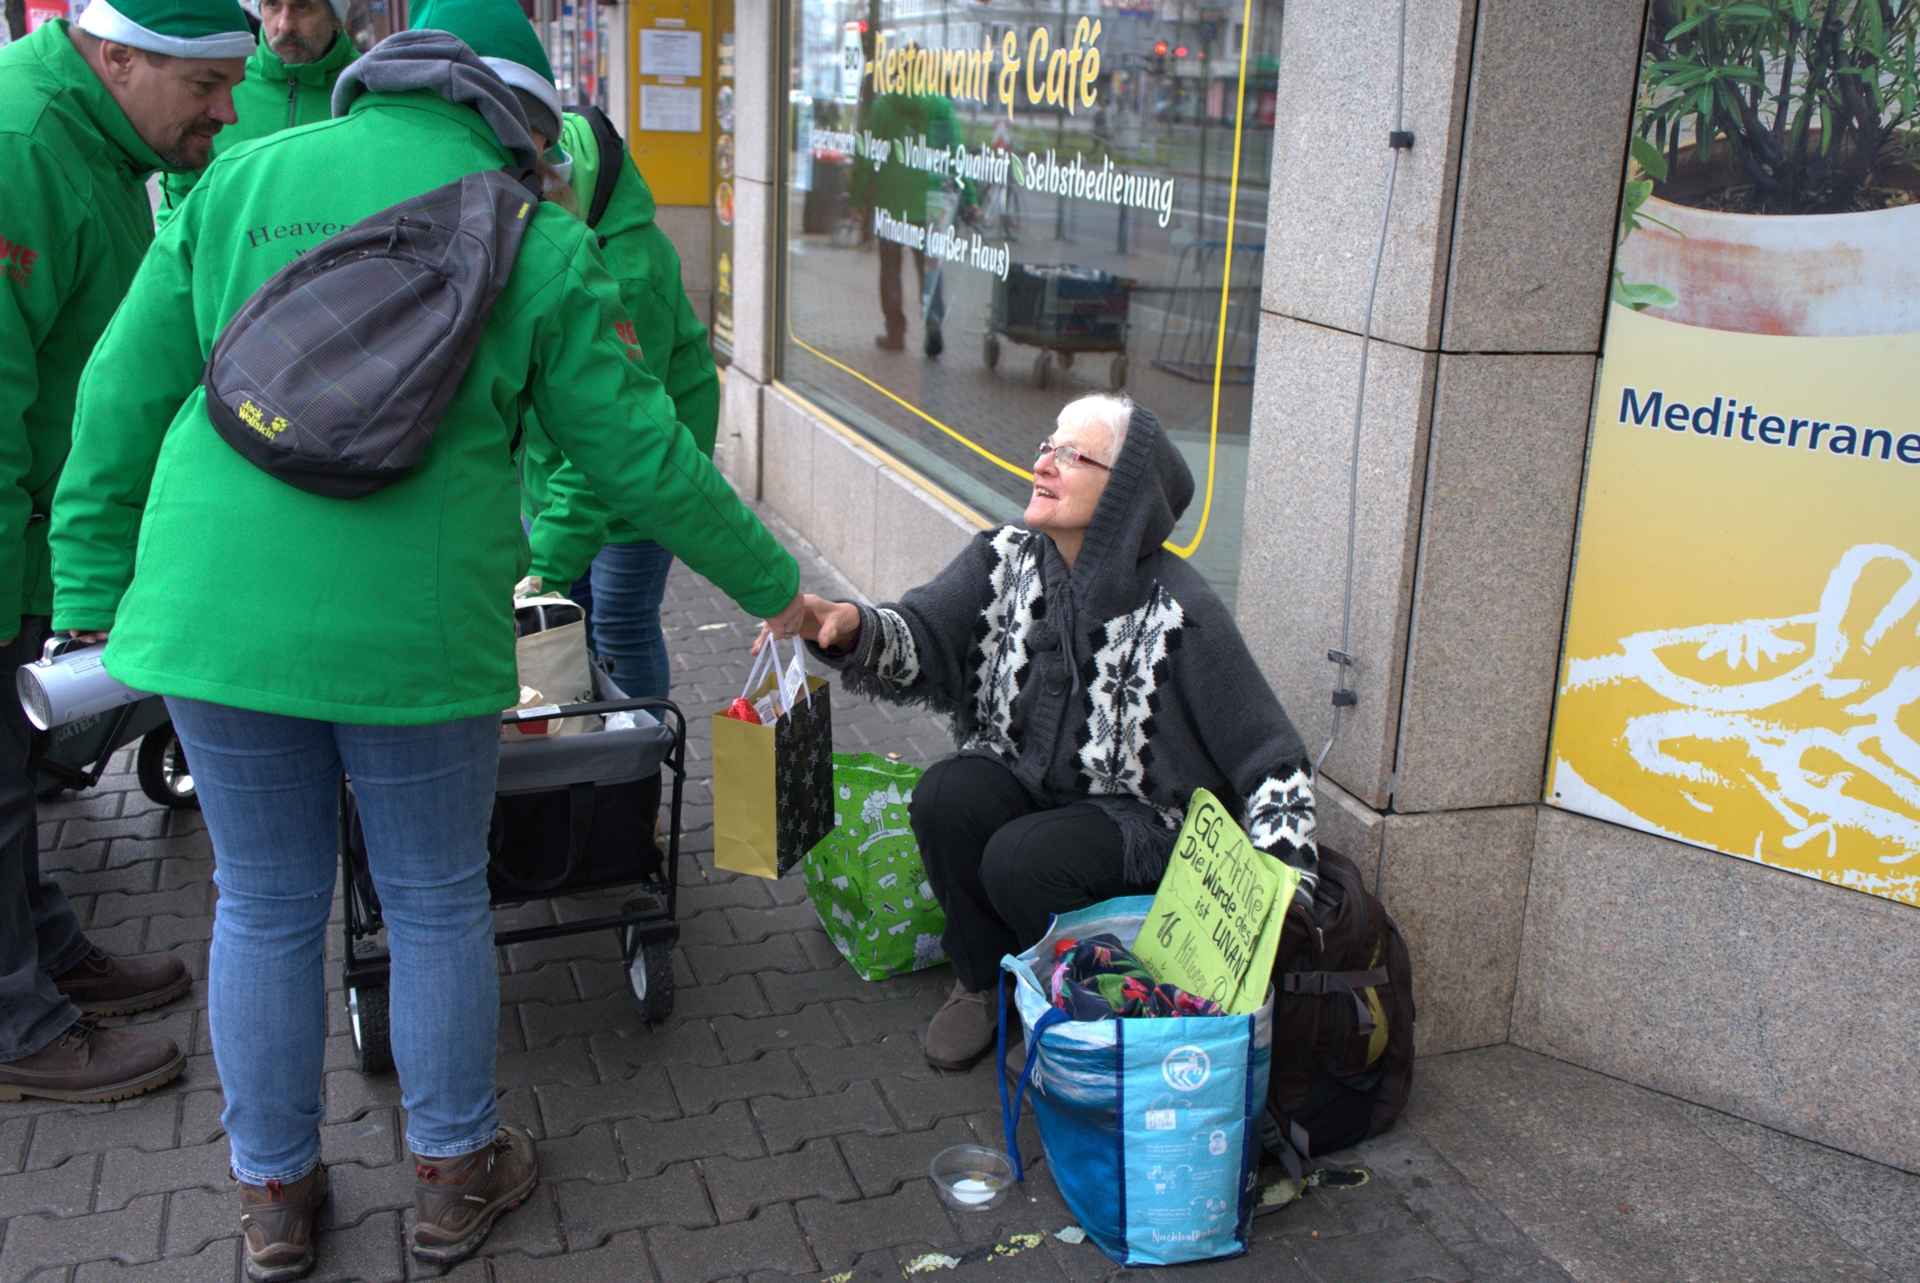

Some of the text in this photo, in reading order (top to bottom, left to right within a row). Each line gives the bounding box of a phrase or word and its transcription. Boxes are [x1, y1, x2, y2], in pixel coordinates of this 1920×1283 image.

[998, 30, 1021, 122] &
[1026, 16, 1102, 117] Café
[807, 123, 1175, 229] egetarisch Vega Vollwert-Qualität Selbstbedienung
[874, 205, 1010, 283] Mitnahme (außer Haus)
[238, 406, 275, 441] Wolfskin
[241, 399, 264, 420] Jack
[1179, 835, 1252, 948] Die Würde des
[1194, 895, 1211, 921] ist
[1156, 910, 1182, 949] 16
